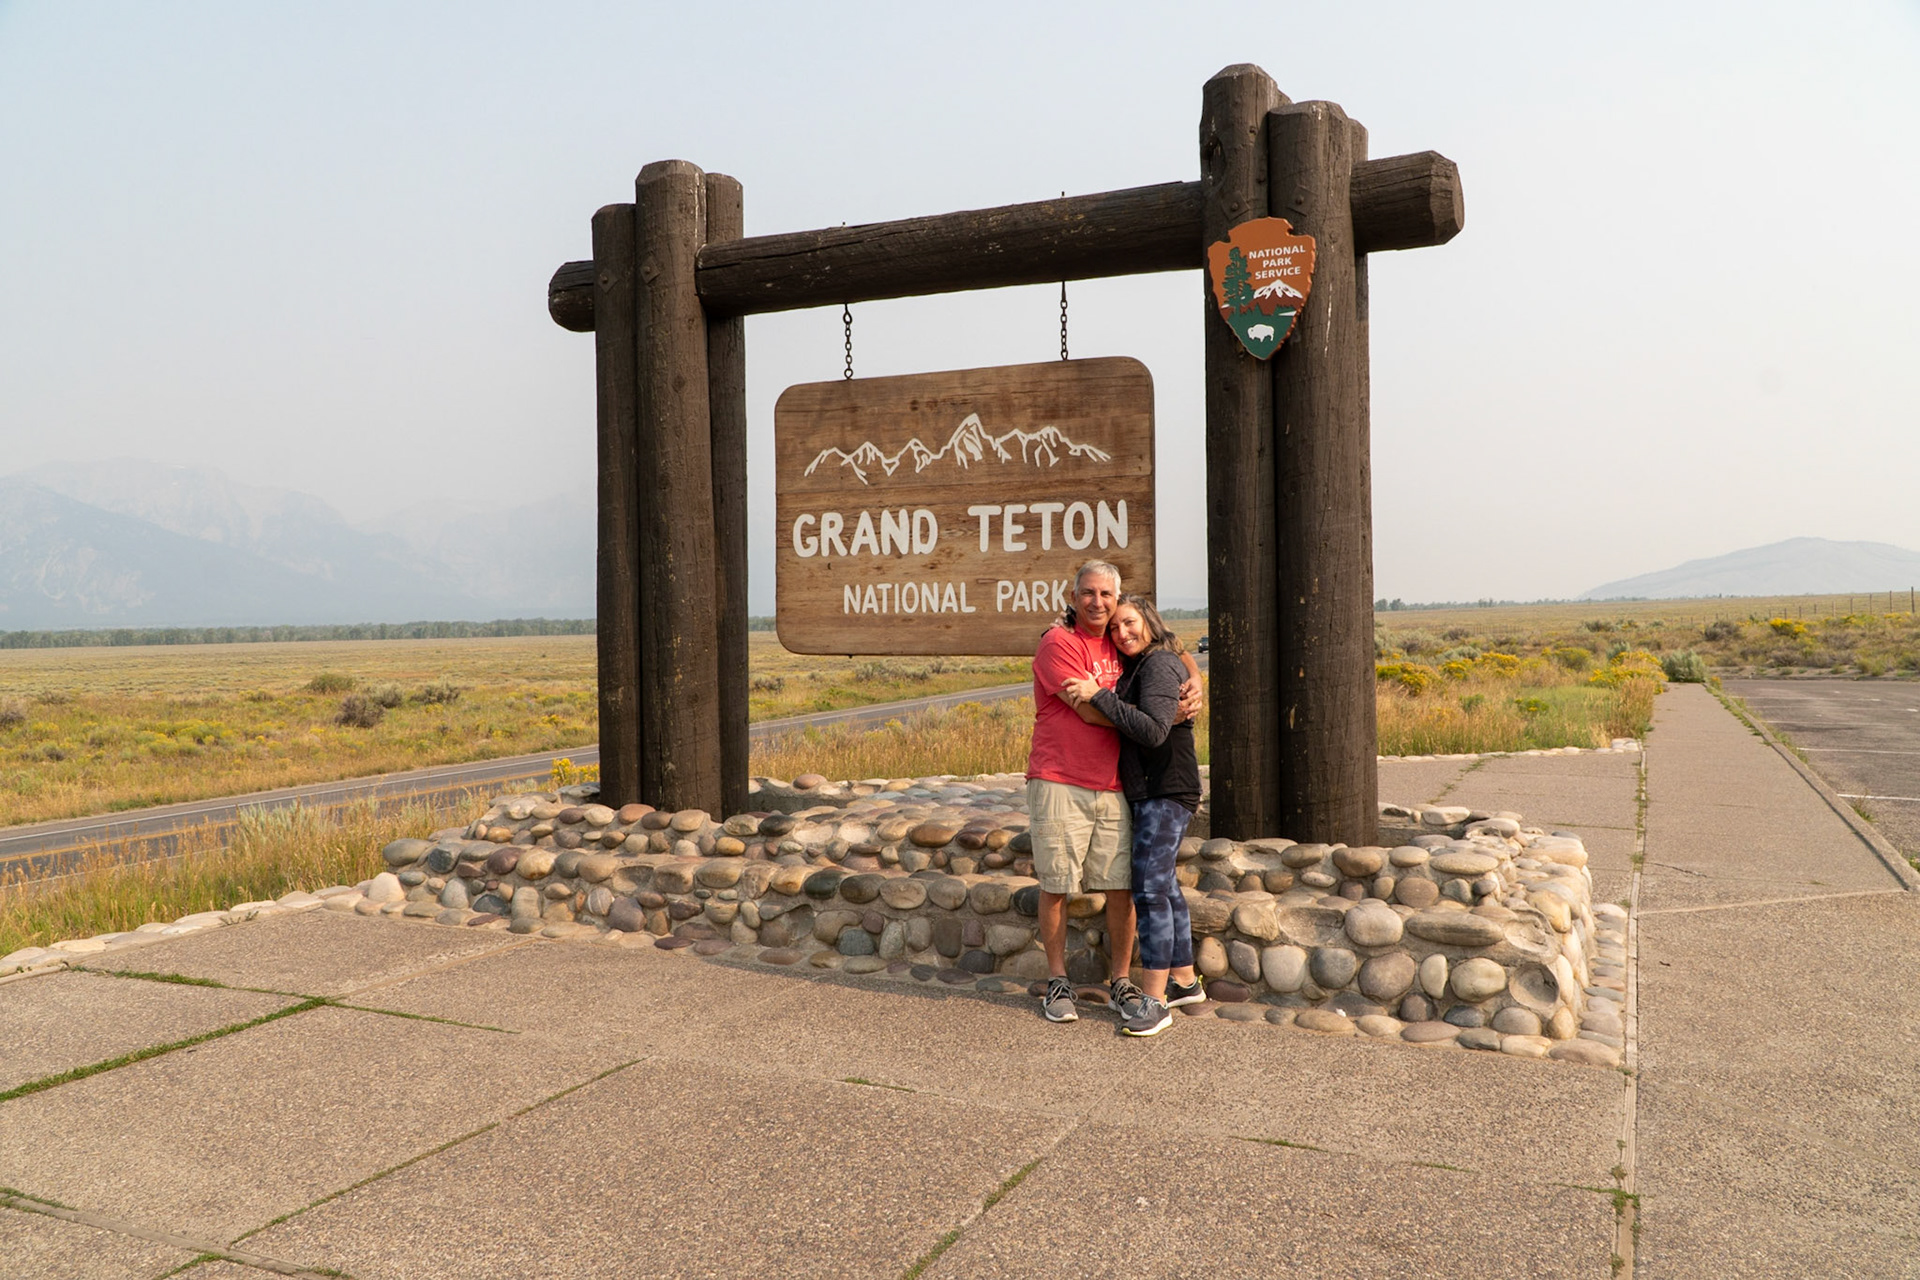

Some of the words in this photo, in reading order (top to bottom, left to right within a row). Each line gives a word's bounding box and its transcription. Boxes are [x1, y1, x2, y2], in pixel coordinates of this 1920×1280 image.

[1249, 245, 1306, 259] NATIONAL
[1262, 257, 1292, 268] PARK
[1255, 266, 1301, 280] SERVICE
[793, 508, 938, 557] GRAND
[967, 500, 1128, 552] TETON
[844, 581, 976, 614] NATIONAL
[997, 579, 1068, 612] PARK
